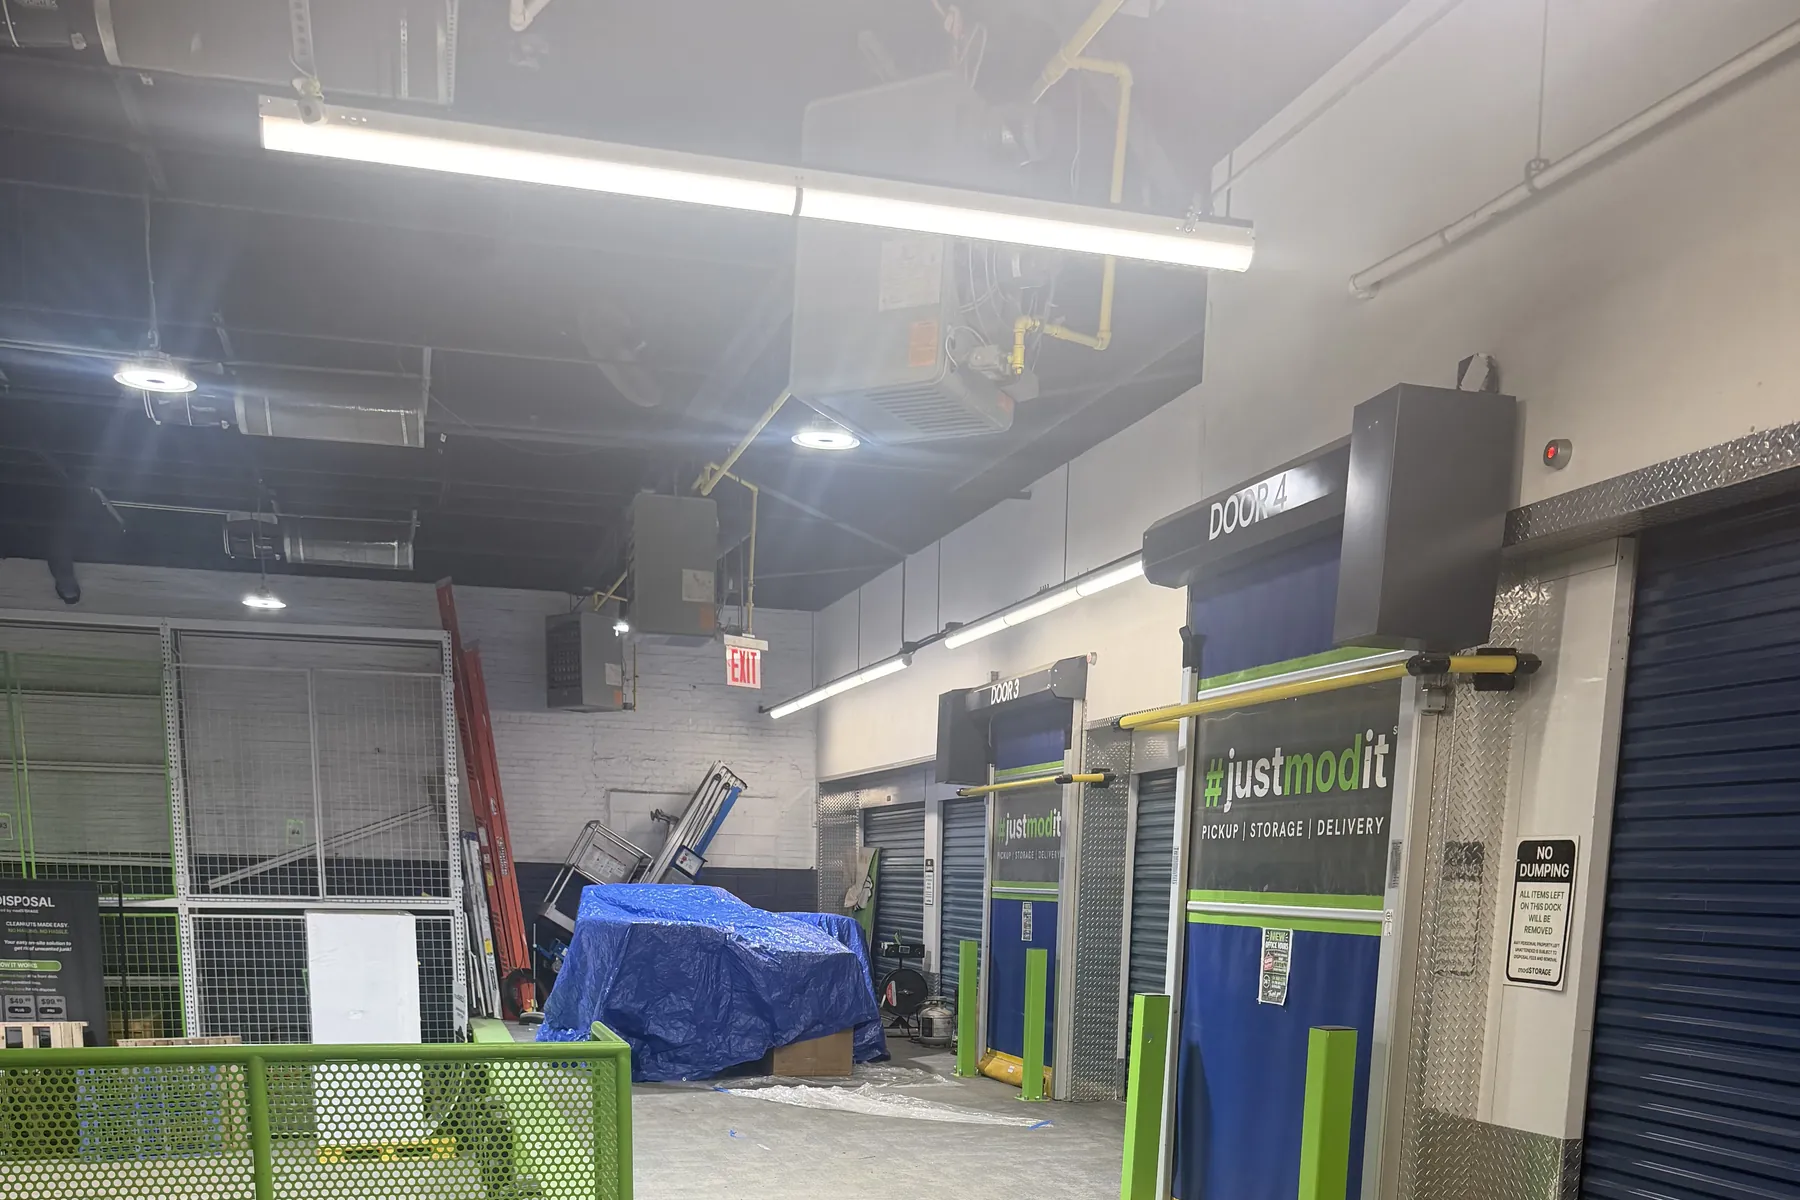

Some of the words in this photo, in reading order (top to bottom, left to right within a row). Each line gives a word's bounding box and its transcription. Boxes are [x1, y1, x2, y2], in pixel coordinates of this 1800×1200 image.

[1208, 482, 1269, 541] DOOR
[1273, 473, 1288, 510] 4
[731, 648, 757, 685] EXIT
[990, 680, 1013, 706] DOOR
[1013, 678, 1020, 699] 3
[1204, 728, 1390, 813] #justmodit
[998, 808, 1062, 846] #justmodit
[1201, 823, 1239, 840] PICKUP
[1250, 820, 1303, 838] STORAGE
[1317, 816, 1385, 836] DELIVERY
[1015, 850, 1034, 860] STORAGE
[1039, 850, 1060, 860] DELIVERY
[1536, 846, 1553, 860] NO
[1520, 863, 1570, 878] DUMPING
[0, 895, 55, 908] ISPOSAL
[1519, 890, 1530, 898] ALL
[1531, 890, 1549, 899] ITEMS
[1550, 891, 1565, 900] LEFT
[1520, 902, 1529, 910] ON
[1530, 902, 1543, 911] THIS
[1544, 903, 1562, 911] DOCK
[1528, 914, 1542, 923] WILL
[1543, 914, 1551, 923] BE
[1524, 925, 1553, 935] REMOVED
[1517, 967, 1552, 976] modSTORAGE
